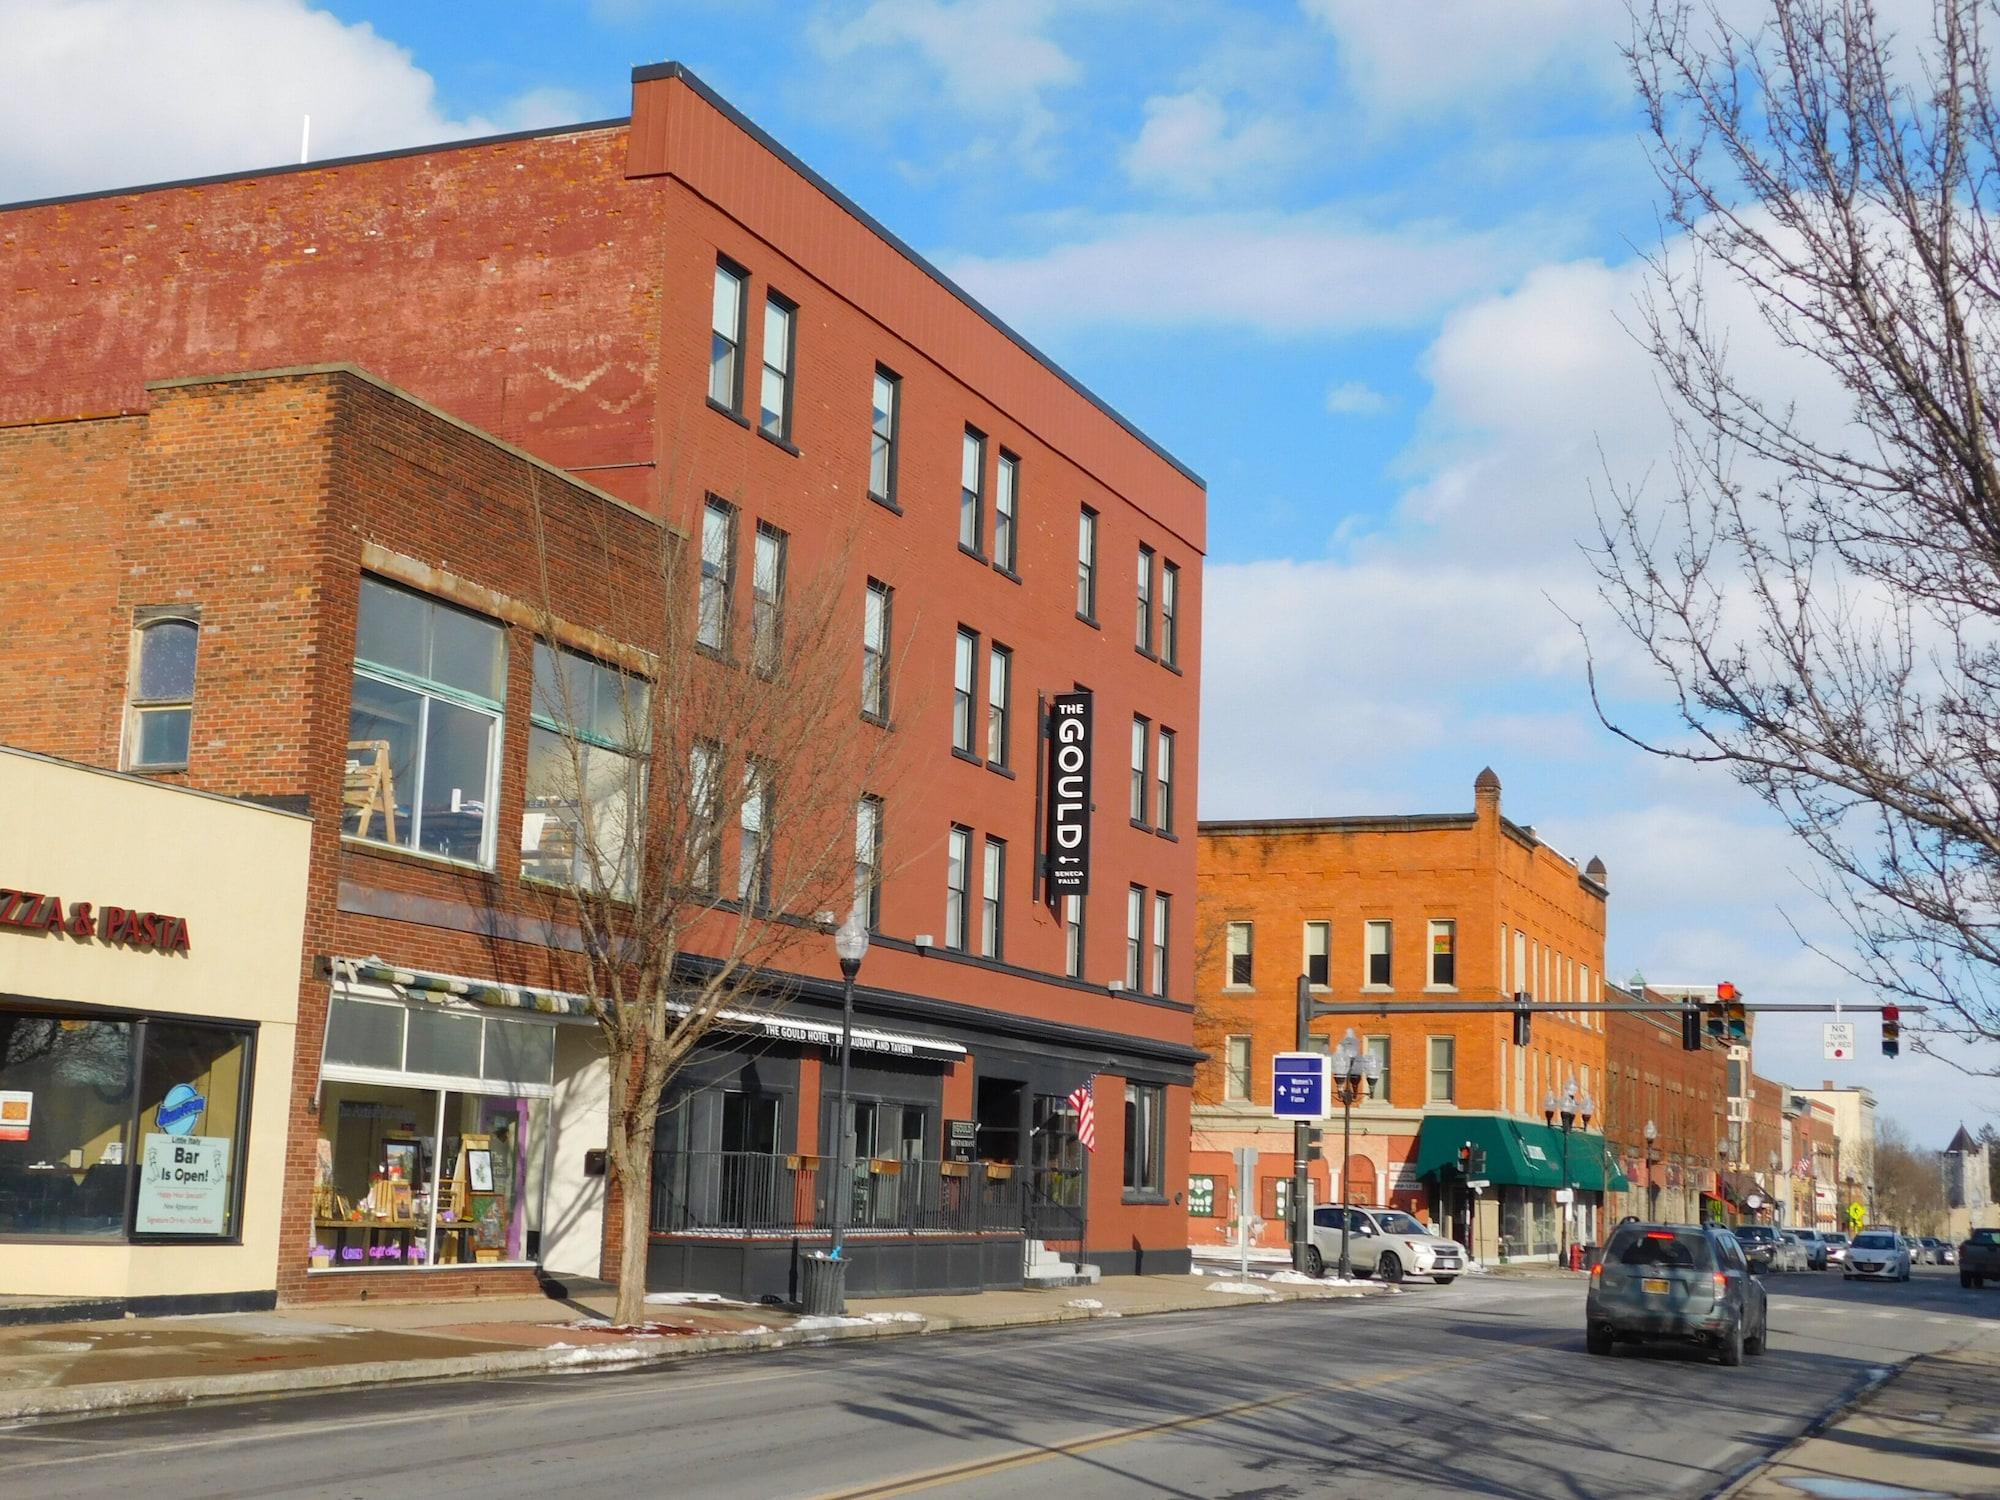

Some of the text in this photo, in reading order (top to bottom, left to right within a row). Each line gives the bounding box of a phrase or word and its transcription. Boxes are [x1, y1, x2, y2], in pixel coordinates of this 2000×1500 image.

[1059, 704, 1084, 715] THE
[1056, 718, 1085, 849] GOULD
[74, 902, 95, 936] &
[106, 906, 191, 950] PASTA
[765, 1024, 780, 1036] THE
[781, 1028, 806, 1040] GOULD
[807, 1031, 830, 1043] HOTEL
[876, 1041, 891, 1051] AND
[890, 1043, 914, 1054] TAVERN
[171, 1136, 187, 1144] Little
[174, 1147, 200, 1164] Bar
[161, 1167, 209, 1185] Is Open!
